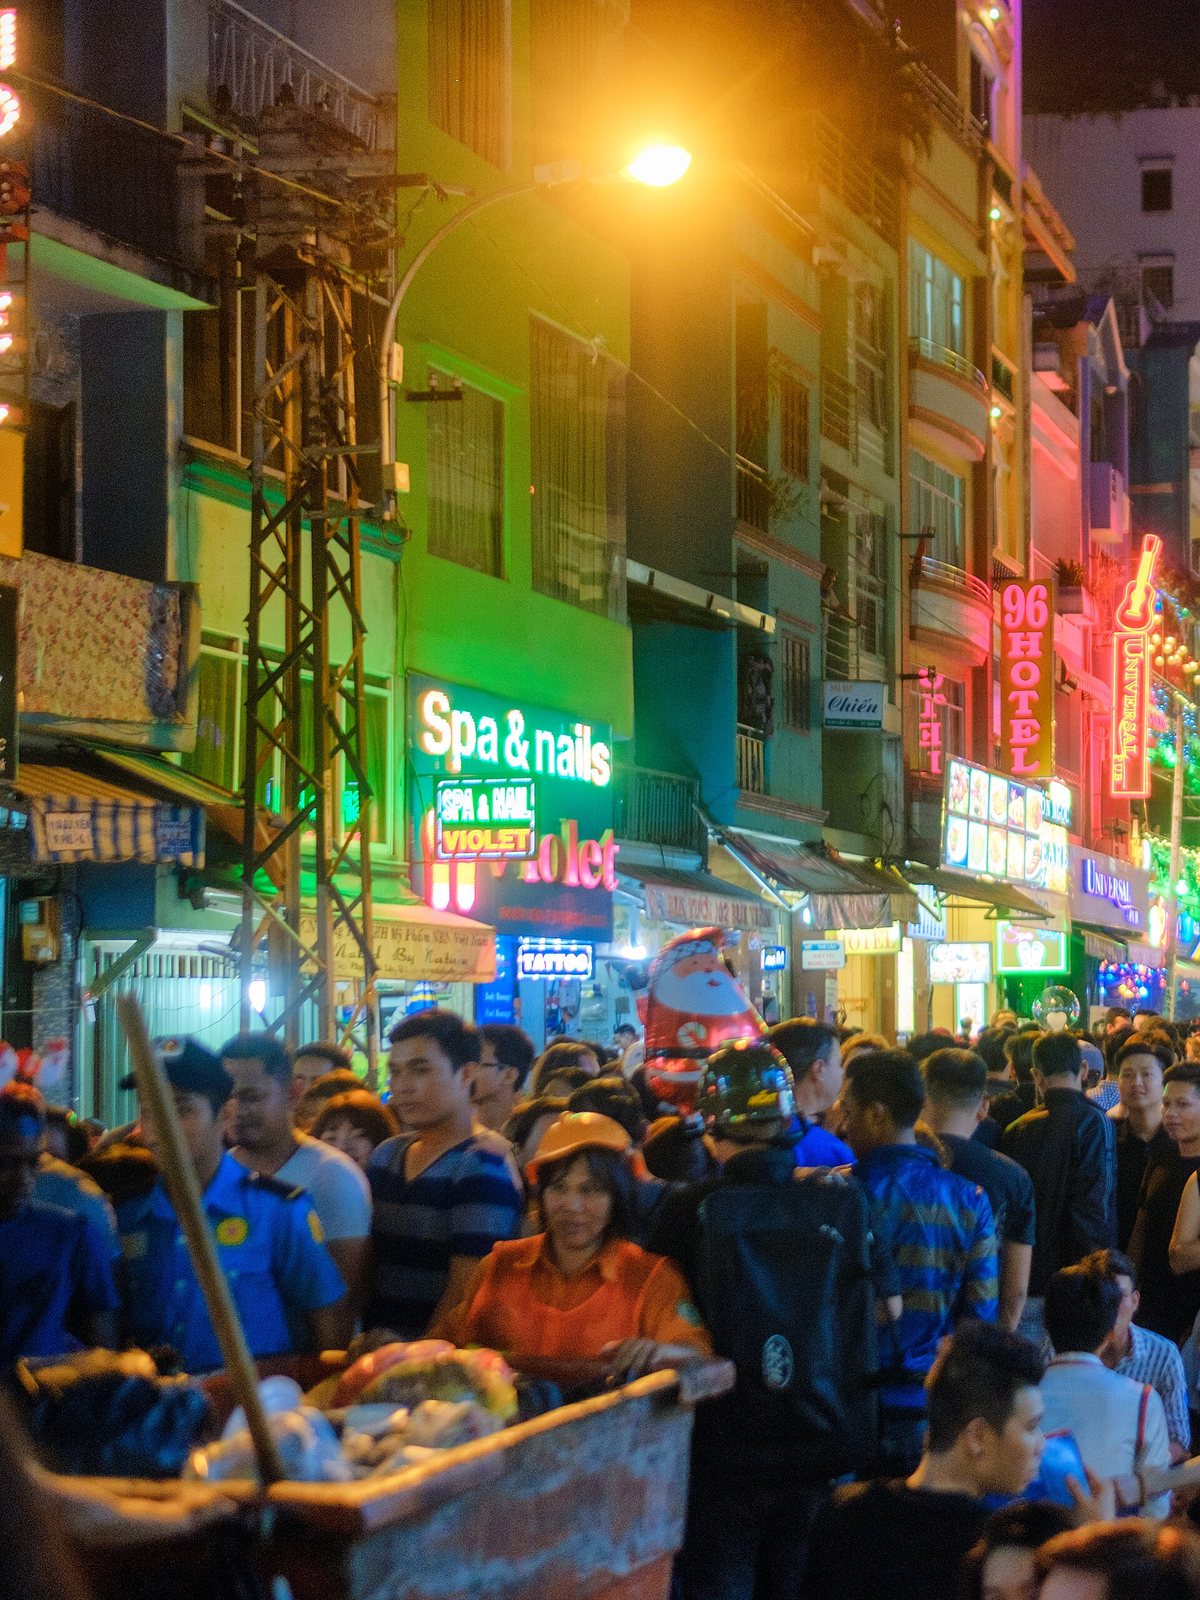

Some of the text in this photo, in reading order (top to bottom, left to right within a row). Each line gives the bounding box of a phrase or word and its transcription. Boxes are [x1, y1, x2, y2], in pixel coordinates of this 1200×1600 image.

[1003, 584, 1048, 630] 96
[828, 695, 879, 714] Chiến
[1007, 631, 1043, 774] HOTEL
[1117, 637, 1144, 758] UNIVERSAL
[417, 690, 612, 788] Spa & nails
[1112, 752, 1123, 783] PUB
[441, 786, 532, 821] SPA & NAIL
[441, 828, 532, 851] VIOLET
[488, 818, 620, 892] olet
[1083, 858, 1133, 909] UNIVERSAL
[336, 943, 381, 960] Nakd
[522, 953, 588, 972] TATTOO
